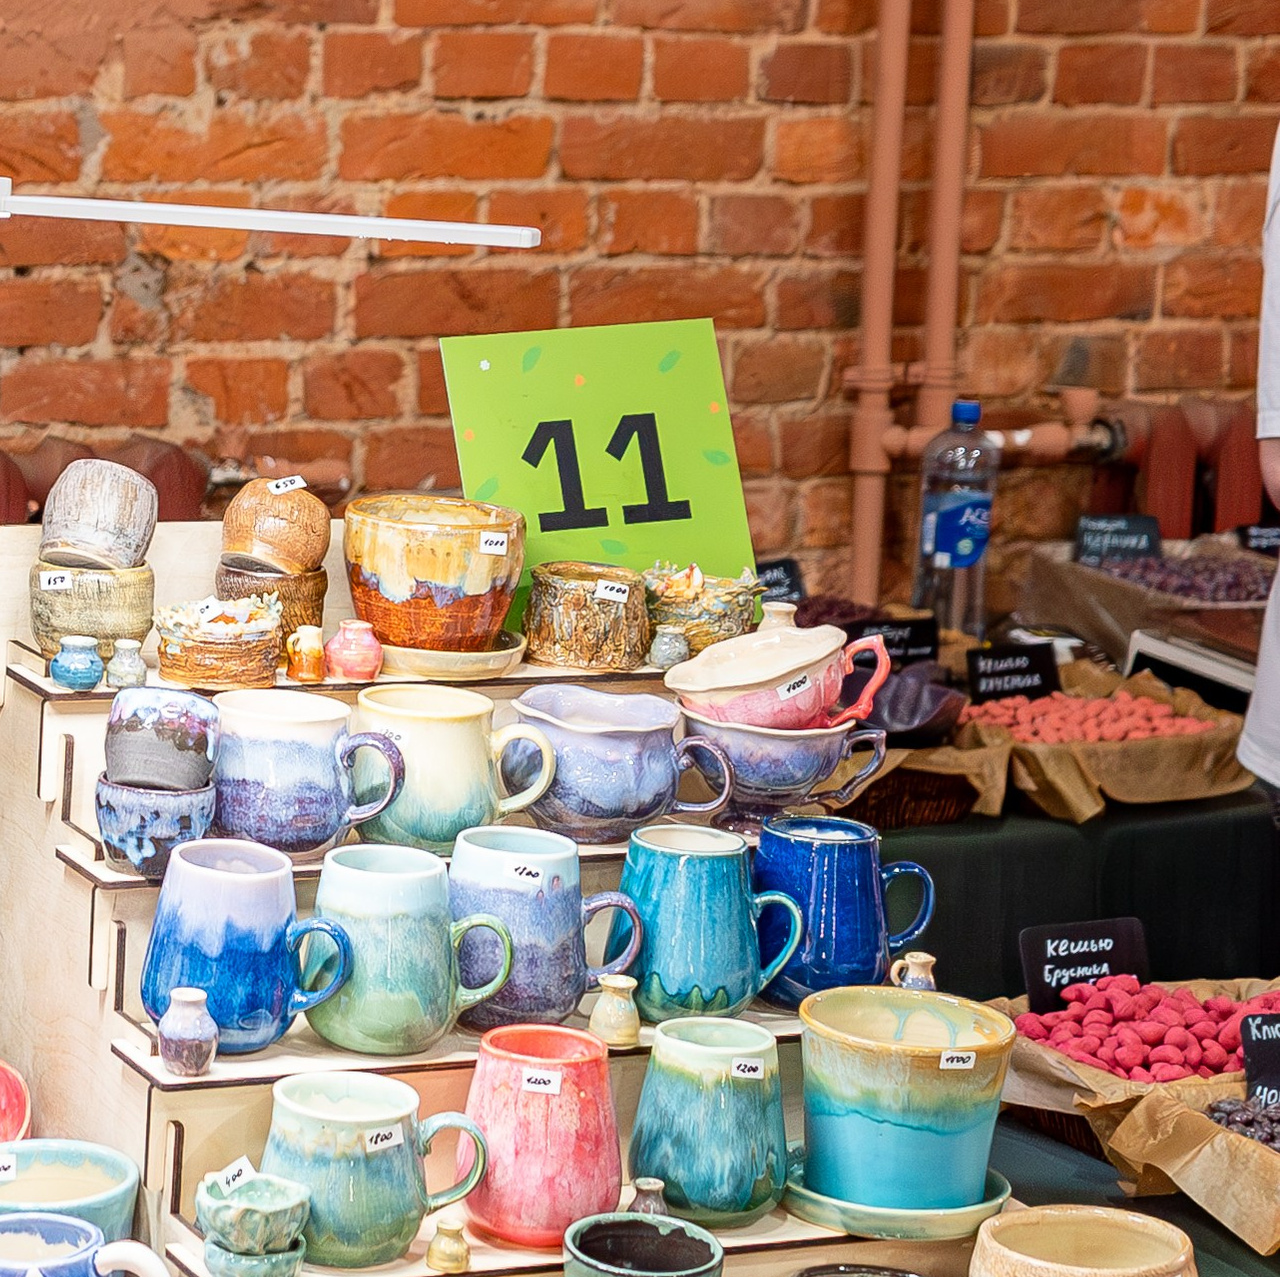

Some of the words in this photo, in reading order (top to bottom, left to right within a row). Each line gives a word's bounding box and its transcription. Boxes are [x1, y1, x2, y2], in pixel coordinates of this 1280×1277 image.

[521, 412, 692, 533] 11
[276, 478, 297, 490] 650
[484, 538, 505, 547] 1000
[604, 586, 627, 595] 1000
[1046, 938, 1114, 958] Кешью
[736, 1062, 760, 1073] 1200
[526, 1075, 552, 1086] 1200
[368, 1130, 393, 1146] 1800
[225, 1168, 244, 1186] 400
